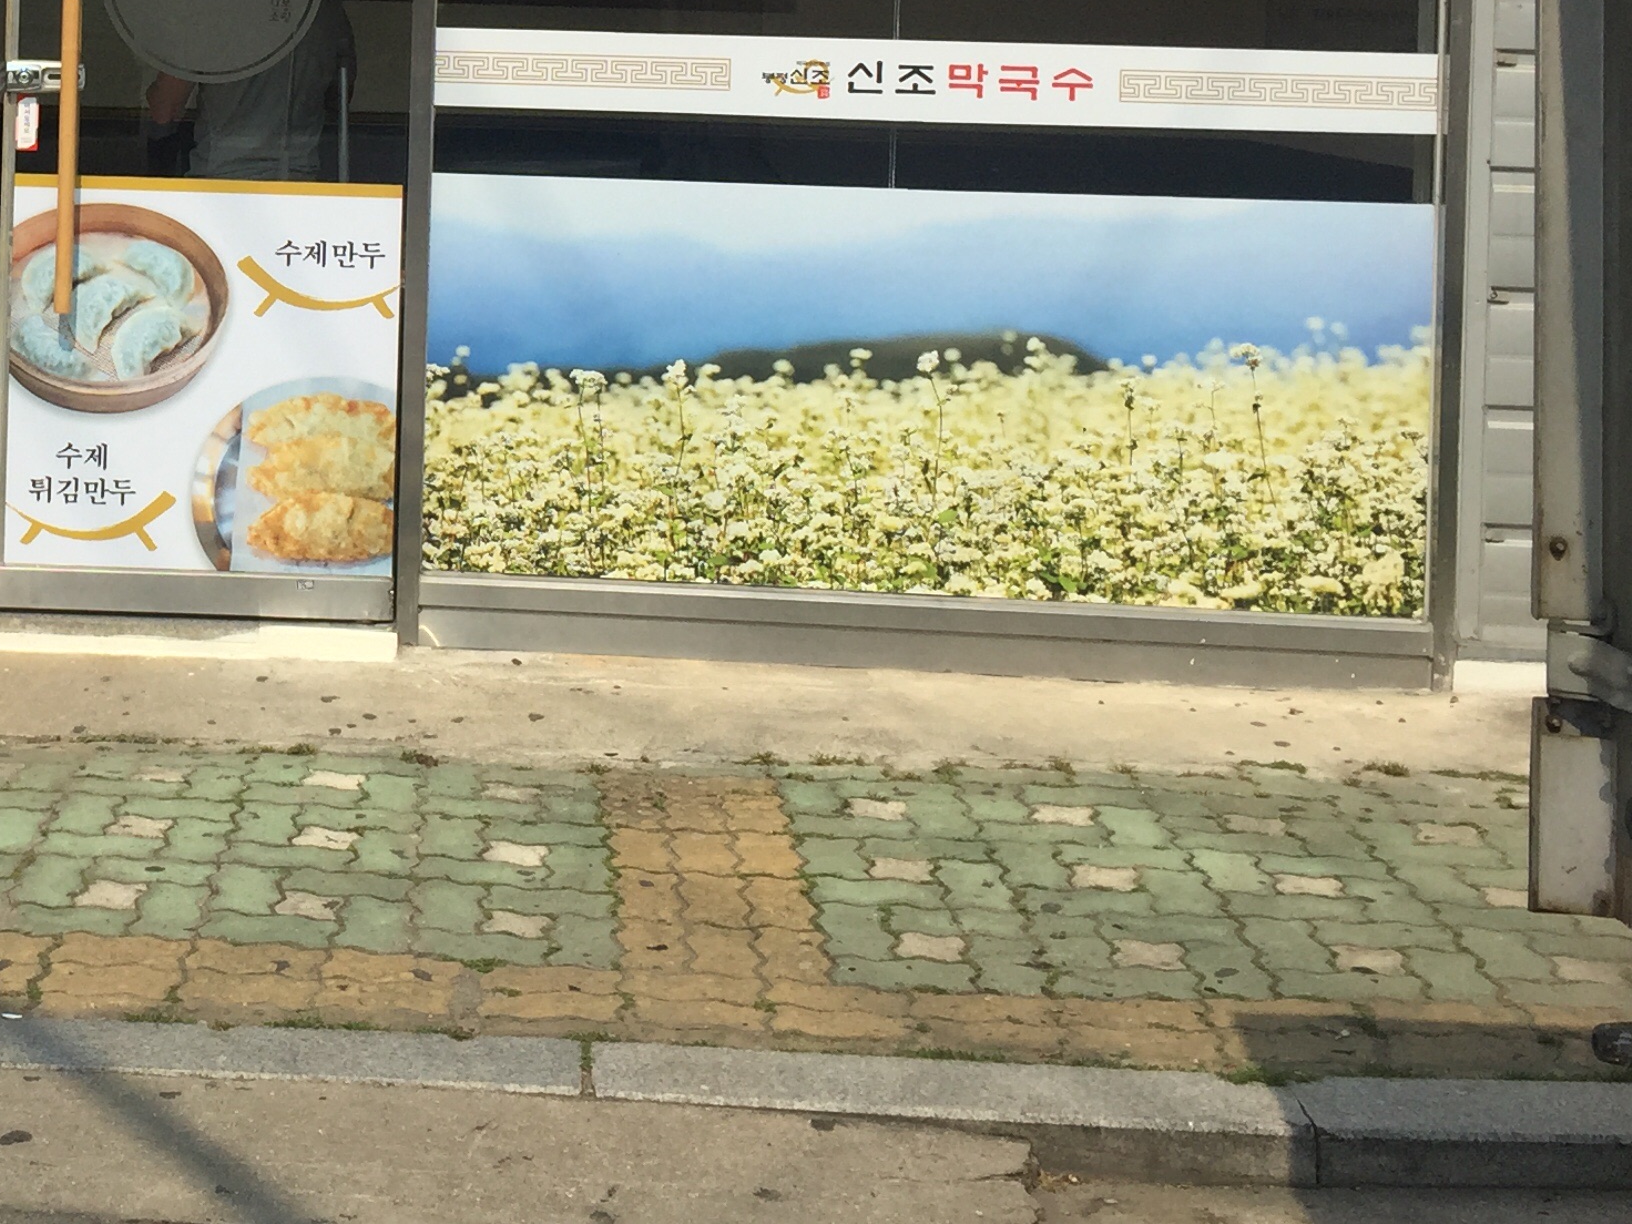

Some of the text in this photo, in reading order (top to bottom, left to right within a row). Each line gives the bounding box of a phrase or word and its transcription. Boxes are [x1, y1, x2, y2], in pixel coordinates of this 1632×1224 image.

[847, 60, 1094, 102] 신조막국수
[274, 239, 386, 270] 수제만두
[55, 442, 108, 471] 수제
[28, 476, 136, 507] 튀김만두
